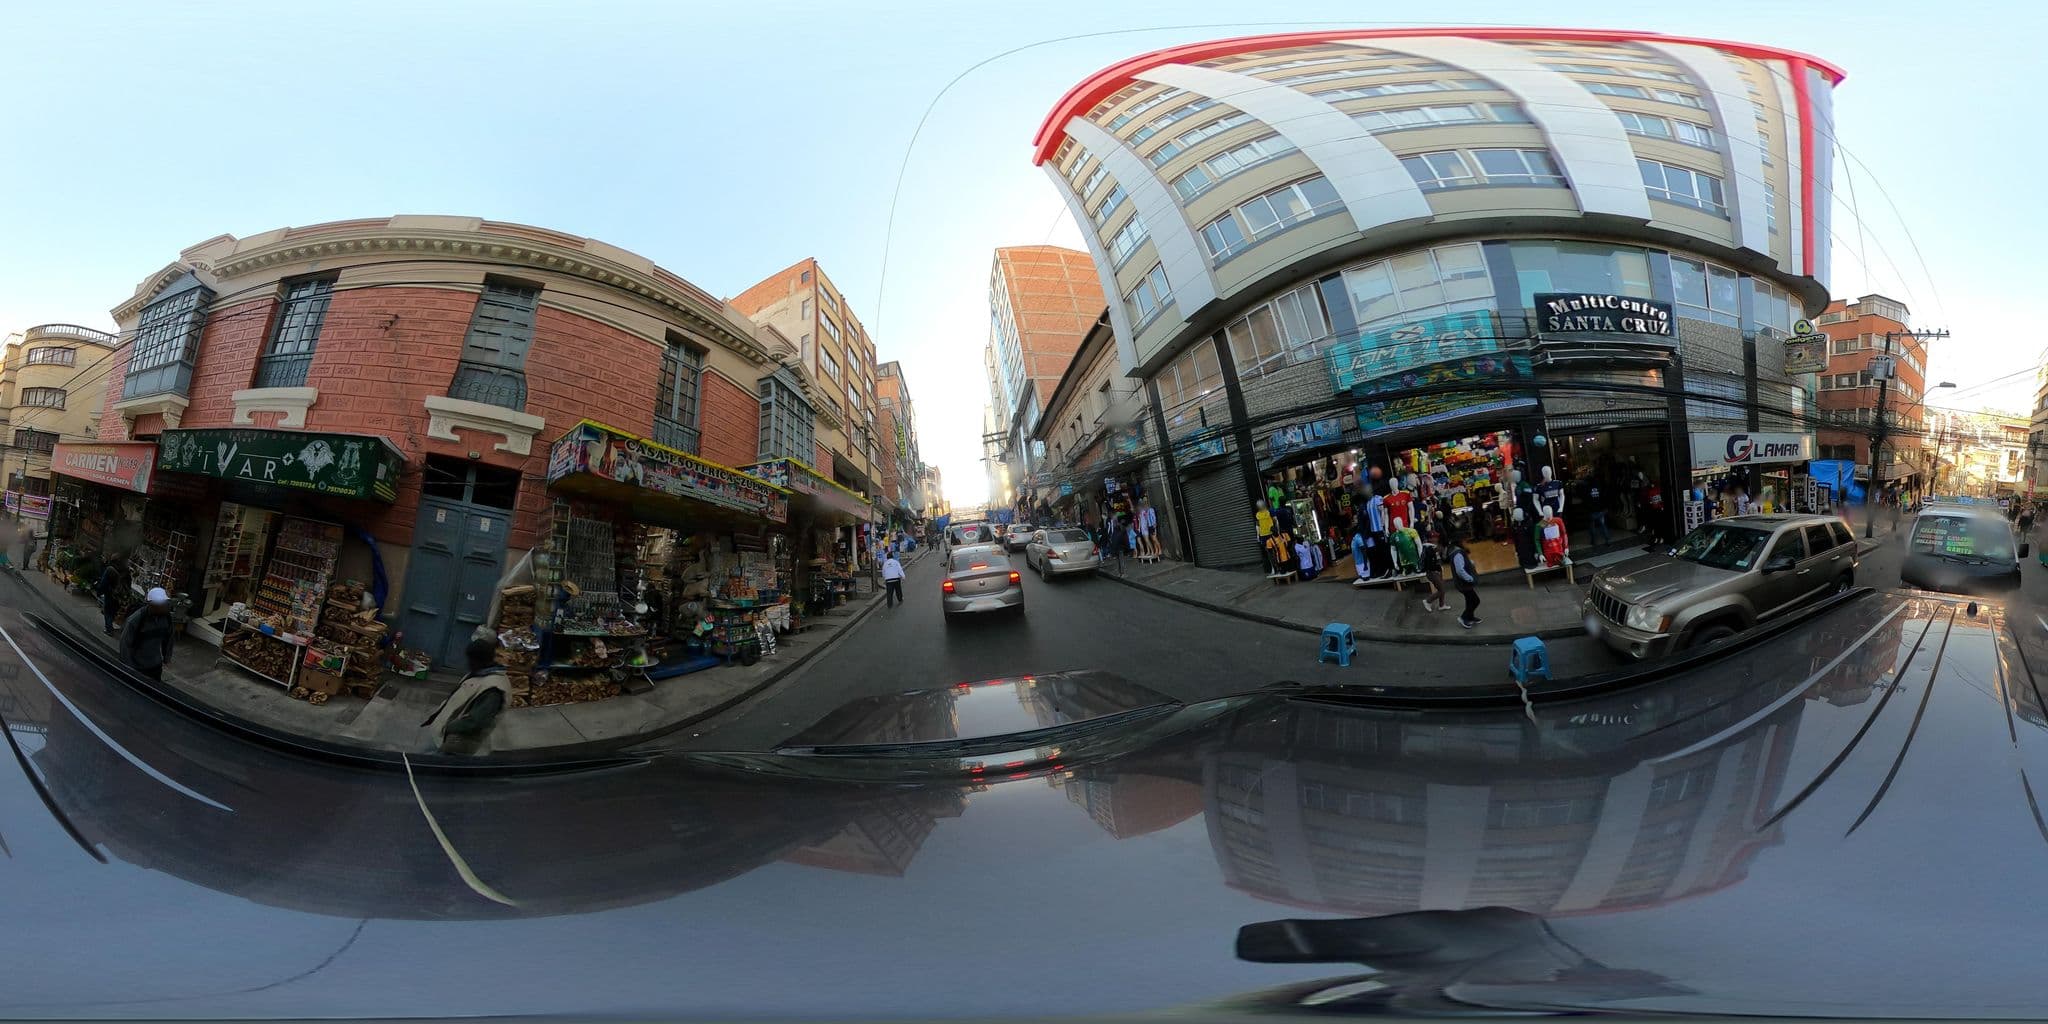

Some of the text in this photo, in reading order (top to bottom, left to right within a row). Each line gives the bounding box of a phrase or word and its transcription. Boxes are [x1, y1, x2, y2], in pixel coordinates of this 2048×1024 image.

[1547, 295, 1667, 320] MultiCentro
[1549, 316, 1670, 335] SANTA CRUZ
[1724, 434, 1799, 463] GLAMAR
[65, 453, 118, 473] CARMEN
[625, 439, 666, 462] CASA
[668, 454, 736, 484] ESOTERICA
